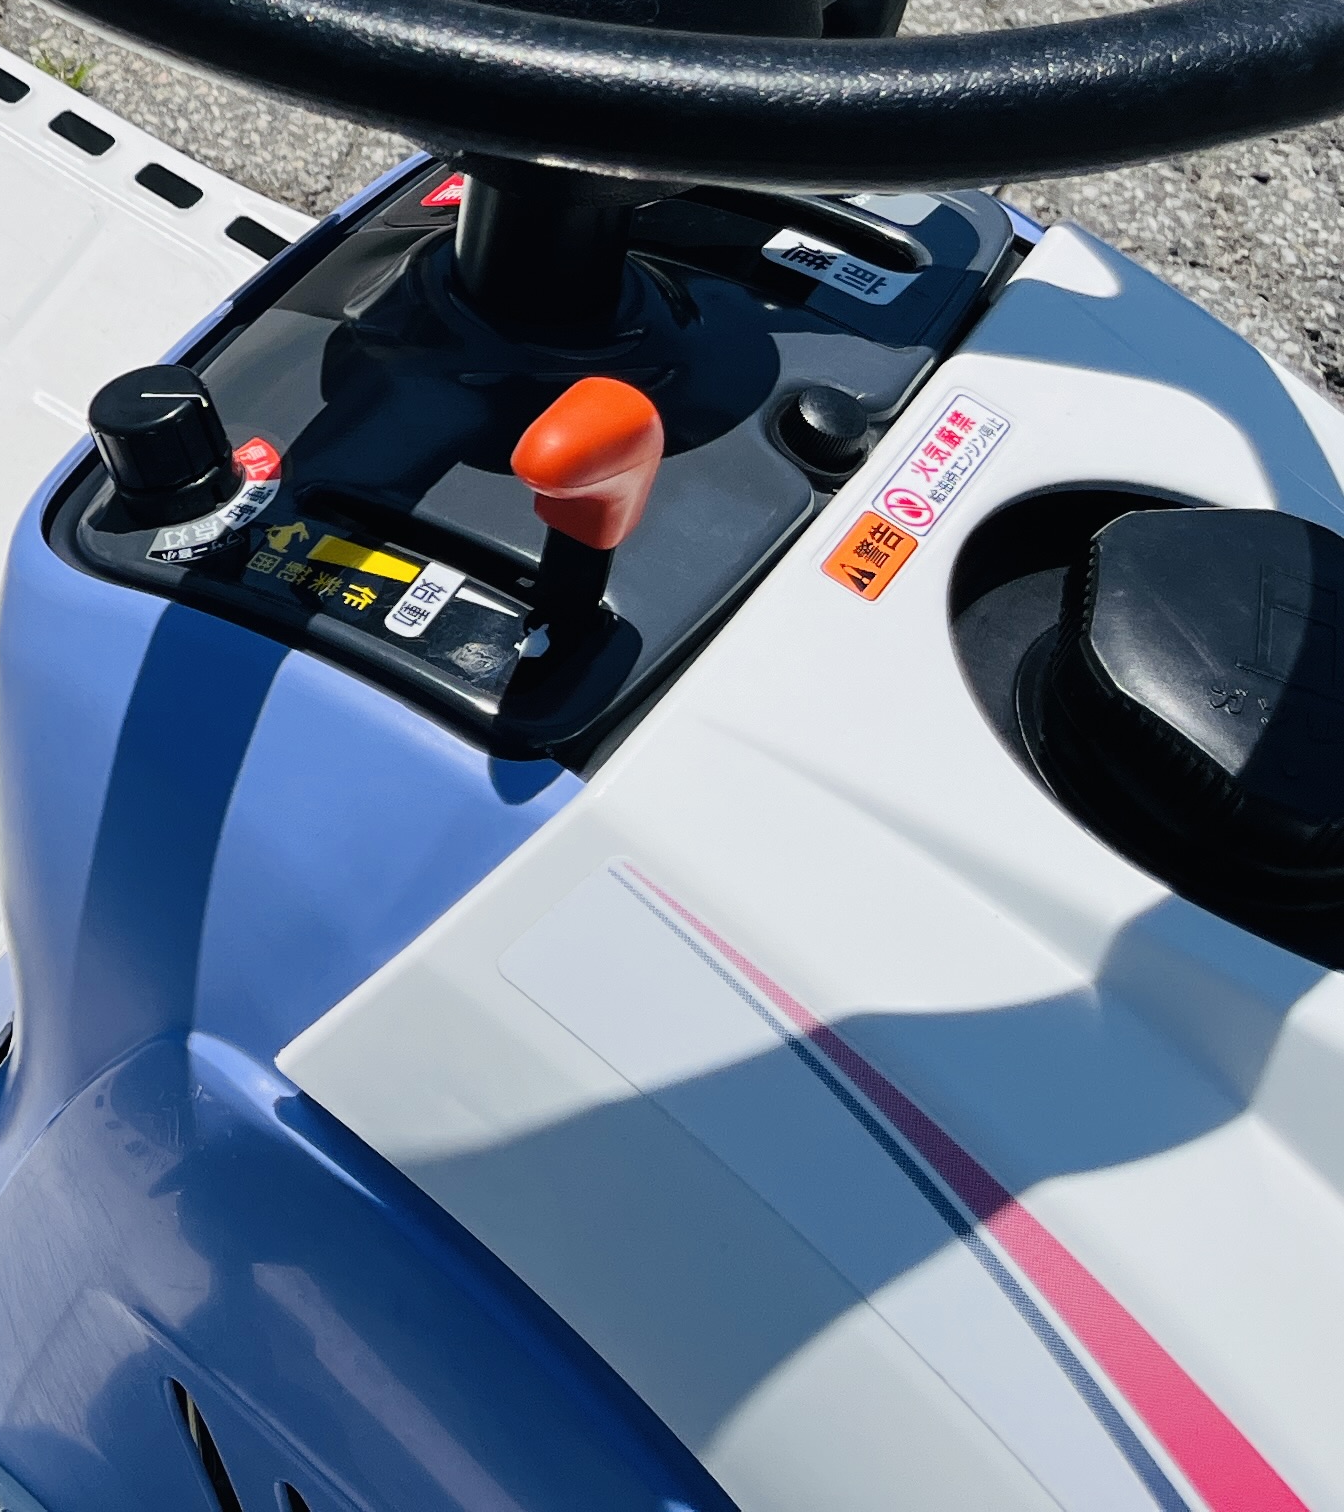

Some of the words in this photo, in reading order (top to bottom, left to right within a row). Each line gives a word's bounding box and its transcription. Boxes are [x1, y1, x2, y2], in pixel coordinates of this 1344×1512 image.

[781, 242, 889, 297] 前進
[909, 409, 978, 485] 火気厳禁
[224, 483, 275, 529] 運転
[163, 519, 221, 550] 点灯
[853, 521, 907, 574] 警告
[248, 550, 379, 613] 作業範囲
[396, 576, 448, 629] 始動
